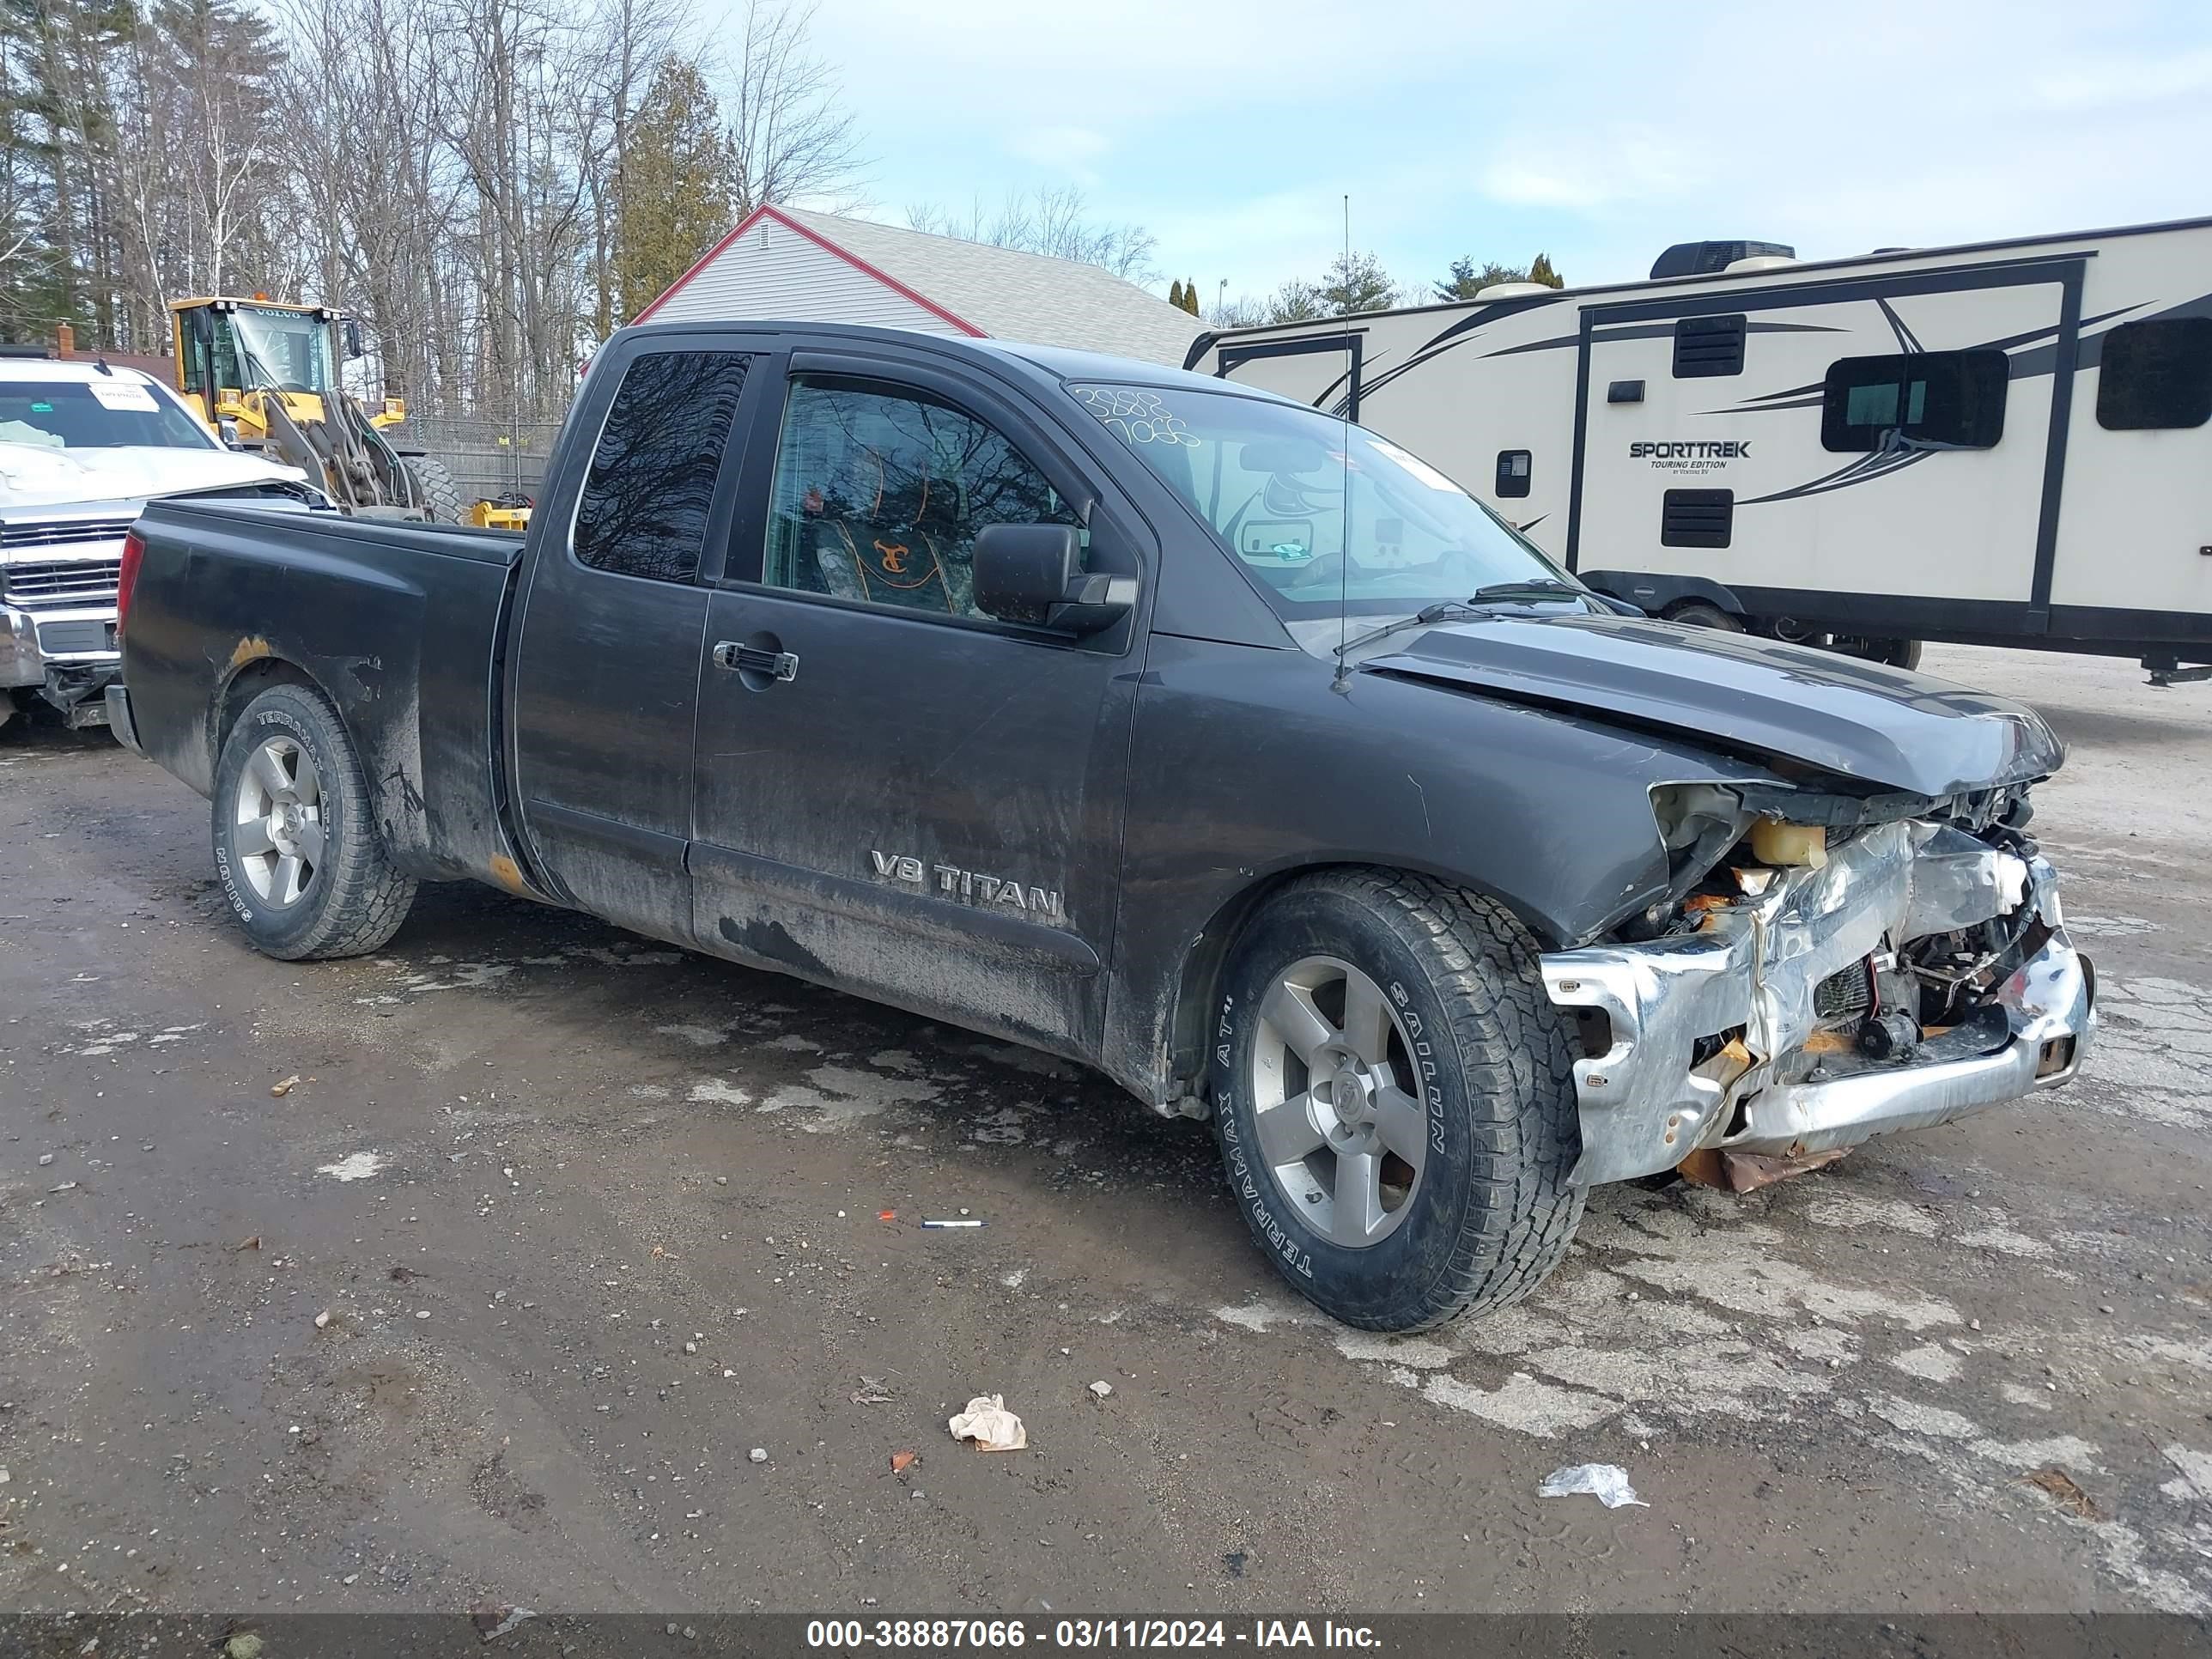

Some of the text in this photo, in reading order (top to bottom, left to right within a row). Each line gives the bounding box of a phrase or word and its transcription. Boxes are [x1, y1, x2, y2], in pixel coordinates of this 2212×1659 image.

[256, 308, 301, 319] VOLVO
[1075, 388, 1173, 418] 3888
[1104, 417, 1201, 447] 7066
[1629, 441, 1753, 459] SPORTTREK
[1650, 460, 1727, 469] TOURING EDITION
[216, 847, 254, 924] SAILUN
[871, 849, 1059, 916] V8 TITAN
[1389, 980, 1446, 1156] SAILUN
[1218, 1091, 1313, 1279] TERRAMAX
